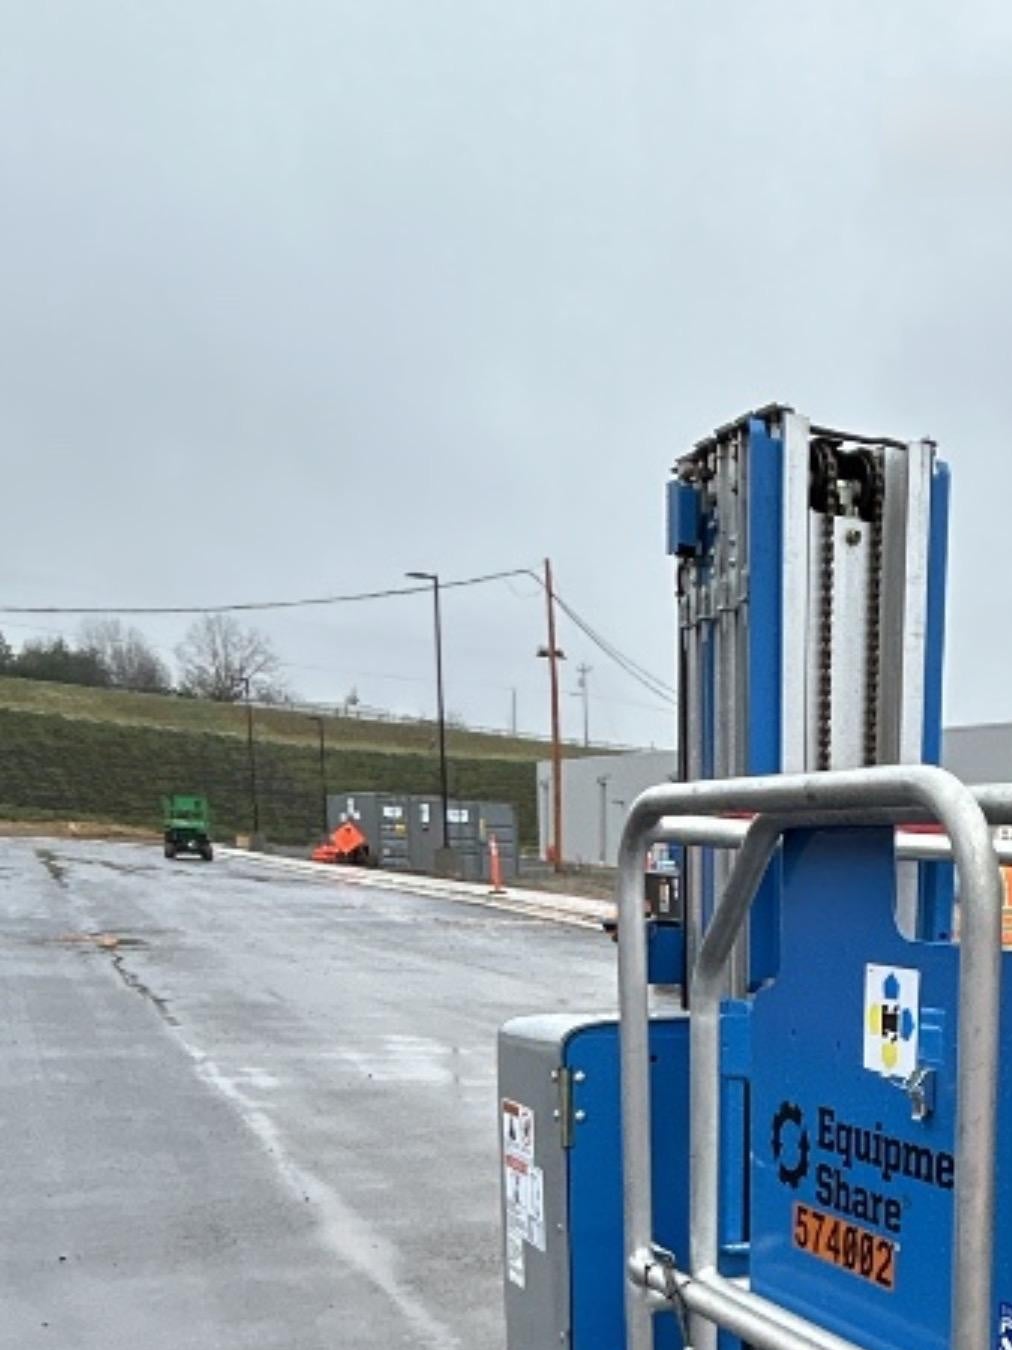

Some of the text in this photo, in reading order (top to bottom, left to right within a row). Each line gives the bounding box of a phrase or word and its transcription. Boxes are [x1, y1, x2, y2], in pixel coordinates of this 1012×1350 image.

[817, 1107, 955, 1189] Equipme
[816, 1162, 902, 1234] Share
[794, 1206, 893, 1287] 574002
